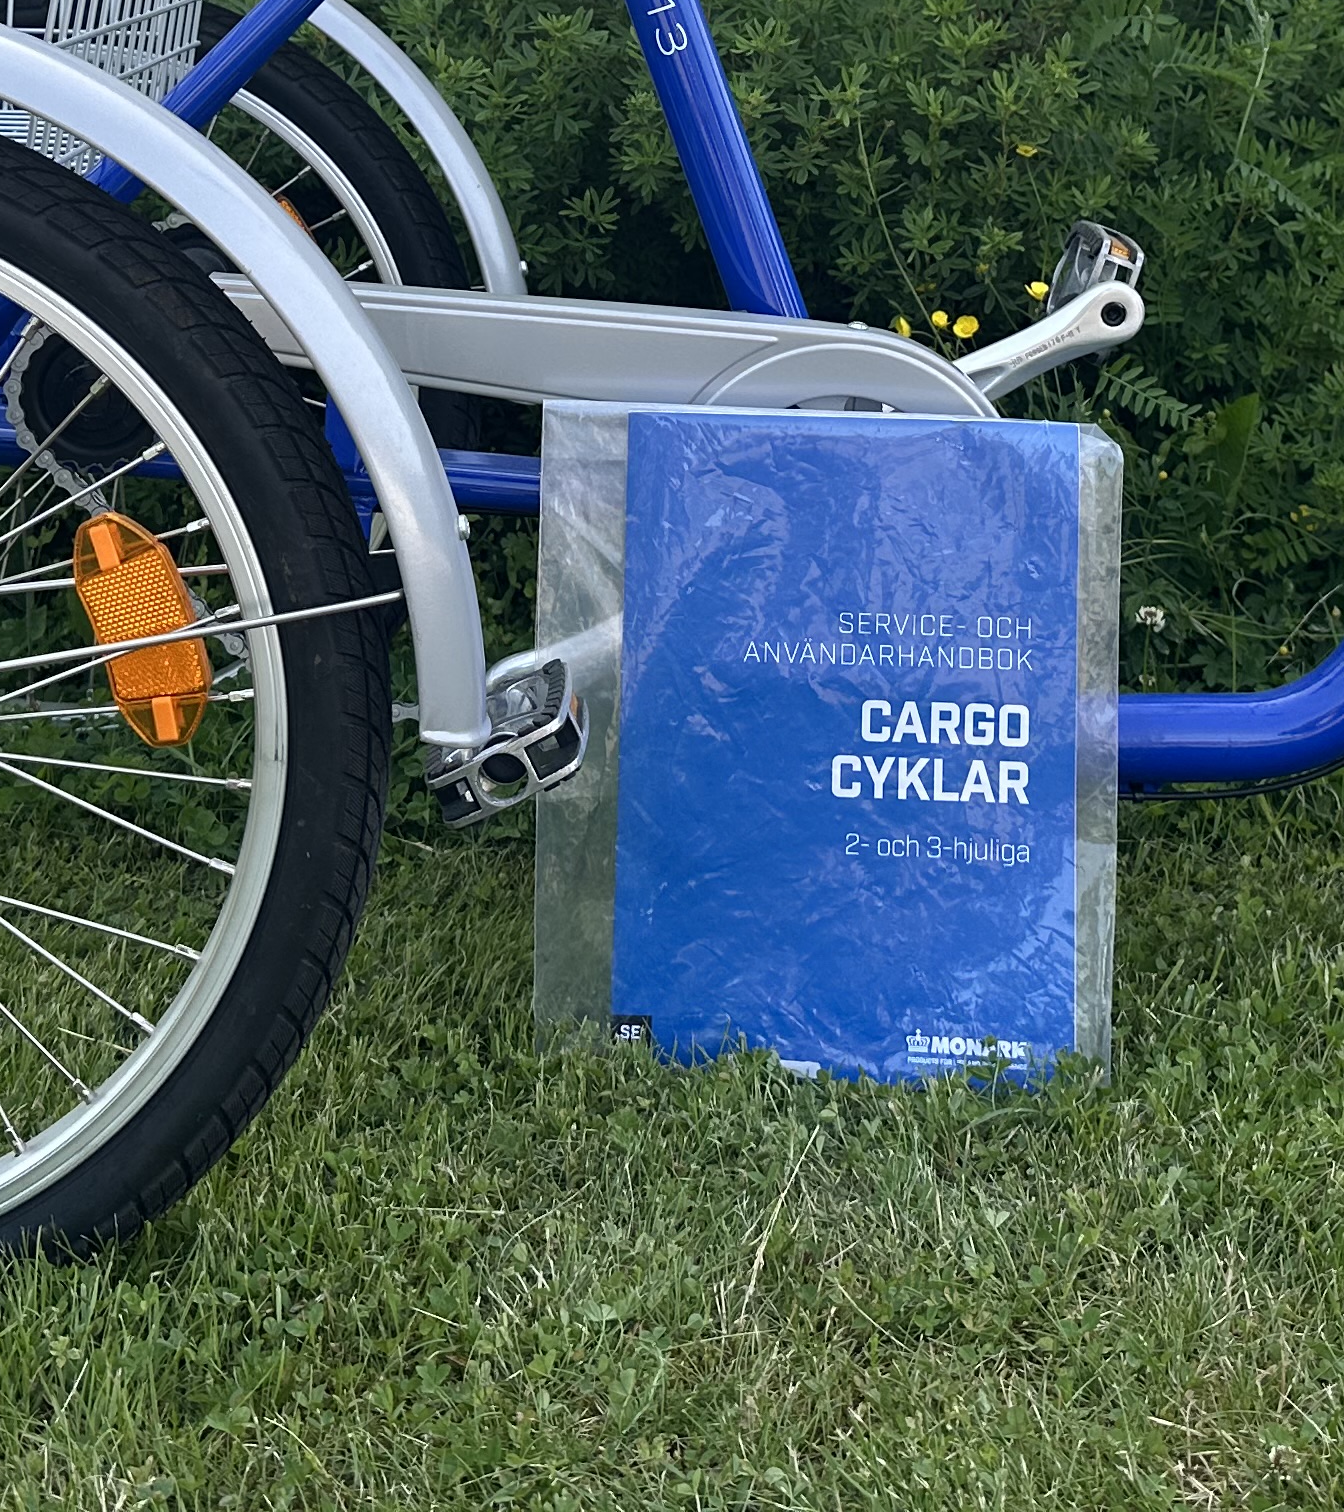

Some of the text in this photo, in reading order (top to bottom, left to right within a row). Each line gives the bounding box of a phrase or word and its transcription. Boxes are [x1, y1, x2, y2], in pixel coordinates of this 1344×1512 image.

[838, 612, 1032, 639] SERVICE- OCH
[743, 638, 1033, 671] ANVÄNDARHANDBOK
[861, 699, 1030, 747] CARGO
[831, 754, 1030, 805] CYKLAR
[845, 833, 1030, 867] 2- och 3-hjuliga
[620, 1024, 641, 1040] SE
